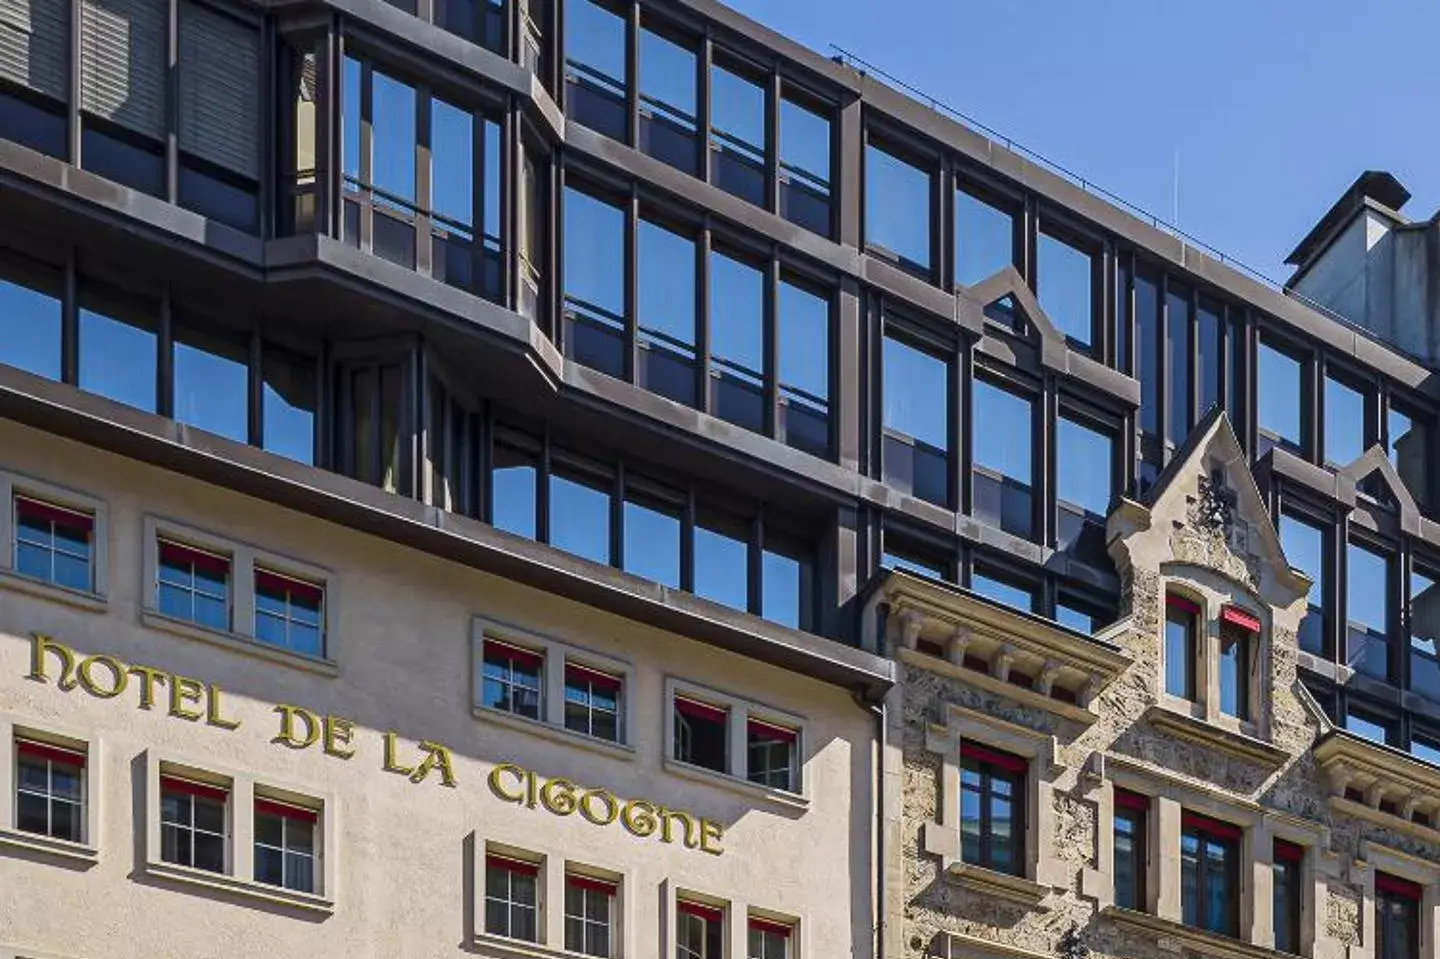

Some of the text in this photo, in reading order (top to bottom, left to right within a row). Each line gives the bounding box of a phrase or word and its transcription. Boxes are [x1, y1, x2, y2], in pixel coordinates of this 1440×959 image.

[24, 631, 725, 856] HOTEL DE LA CIGOGNE
